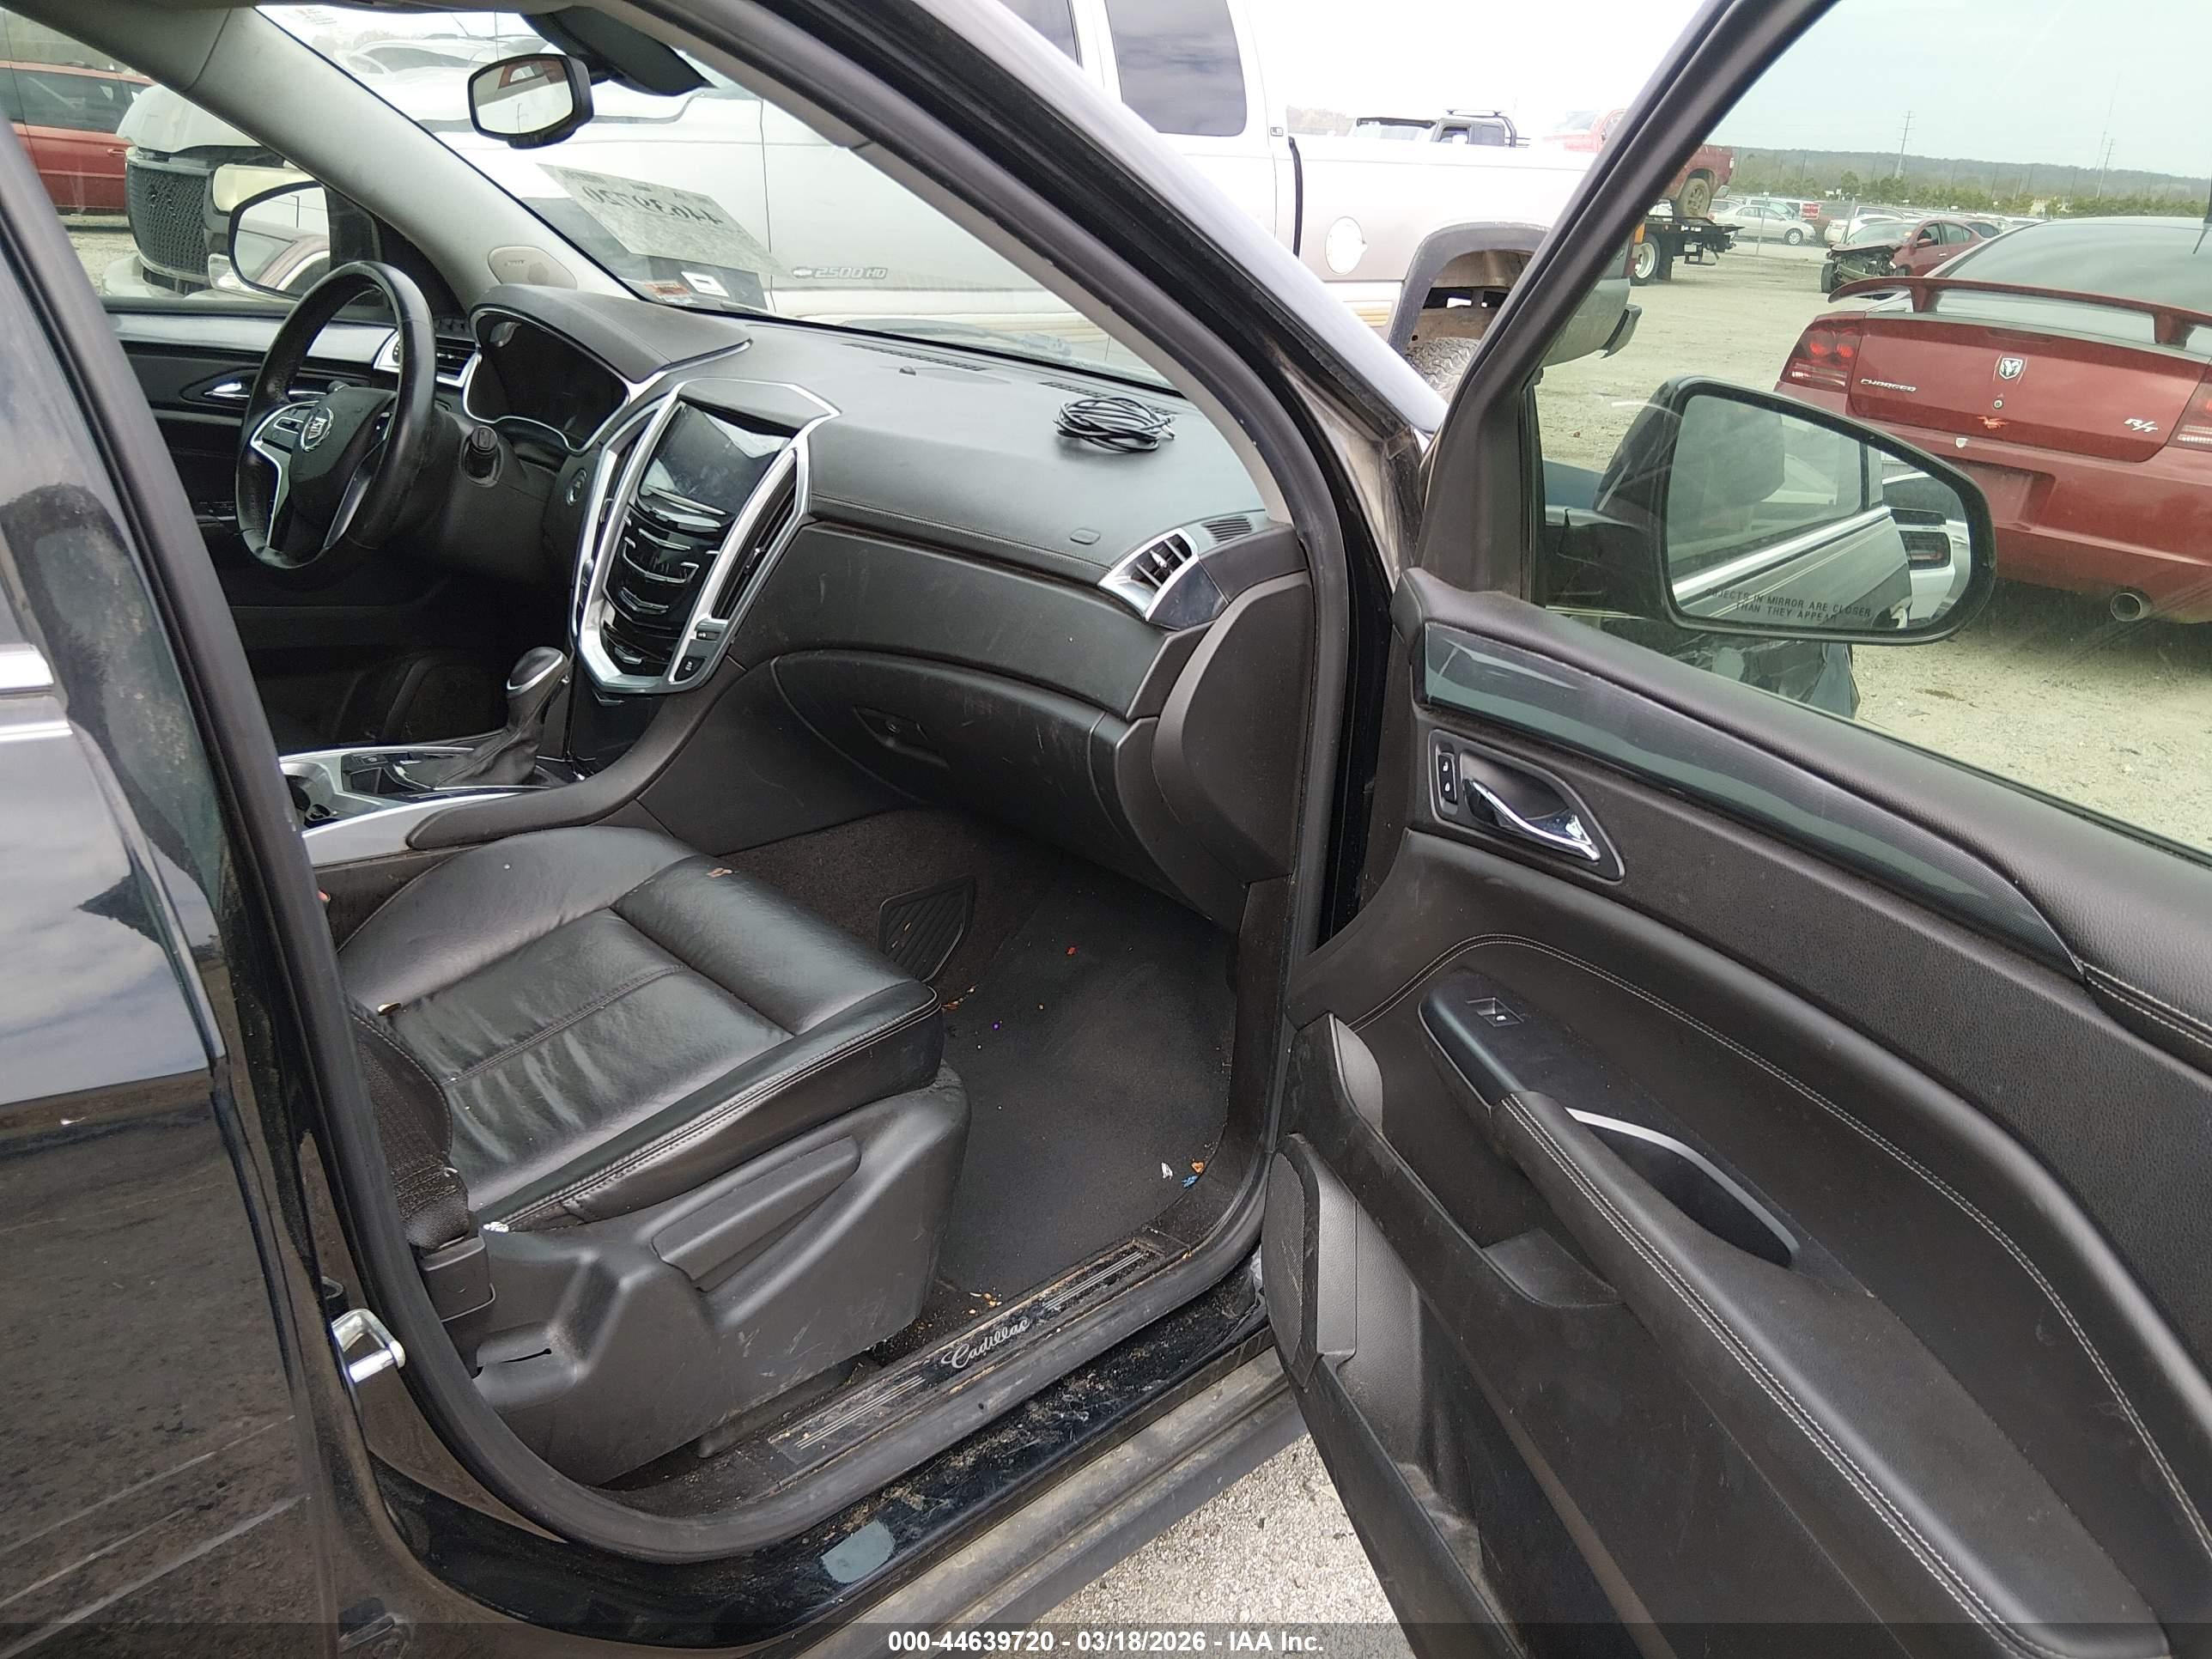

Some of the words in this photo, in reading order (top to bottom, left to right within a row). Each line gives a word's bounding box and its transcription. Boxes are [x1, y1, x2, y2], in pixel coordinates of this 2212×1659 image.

[814, 266, 864, 280] 2500
[865, 266, 889, 279] HD
[1859, 378, 1917, 392] CHARGER
[2123, 417, 2160, 433] R/T
[1705, 587, 1748, 601] OBJECTS
[1766, 596, 1803, 609] MIRROR
[1808, 601, 1828, 611] ARE
[1832, 604, 1872, 617] CLOSER
[1735, 603, 1760, 612] THAN
[1767, 606, 1793, 617] THEY
[1796, 612, 1837, 623] APPEAR
[940, 1316, 1031, 1369] Cadillac
